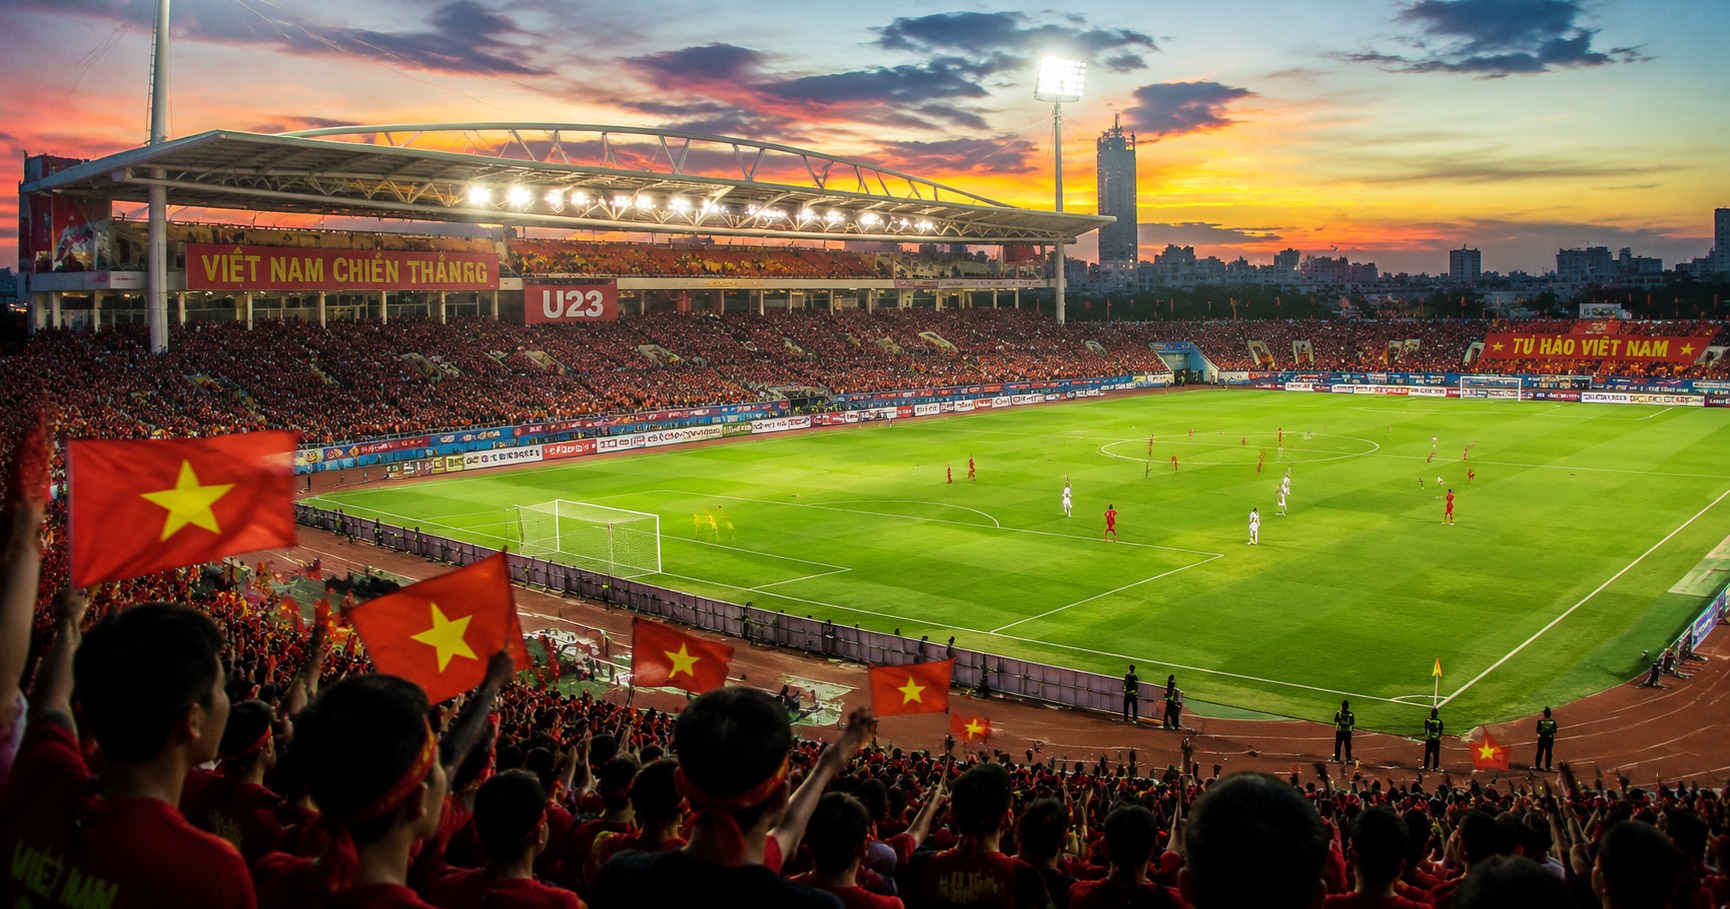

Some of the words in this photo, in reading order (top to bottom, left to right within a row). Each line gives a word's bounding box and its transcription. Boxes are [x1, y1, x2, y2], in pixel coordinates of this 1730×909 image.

[270, 256, 325, 283] NAM
[542, 289, 604, 318] U23
[1625, 340, 1669, 357] NAM
